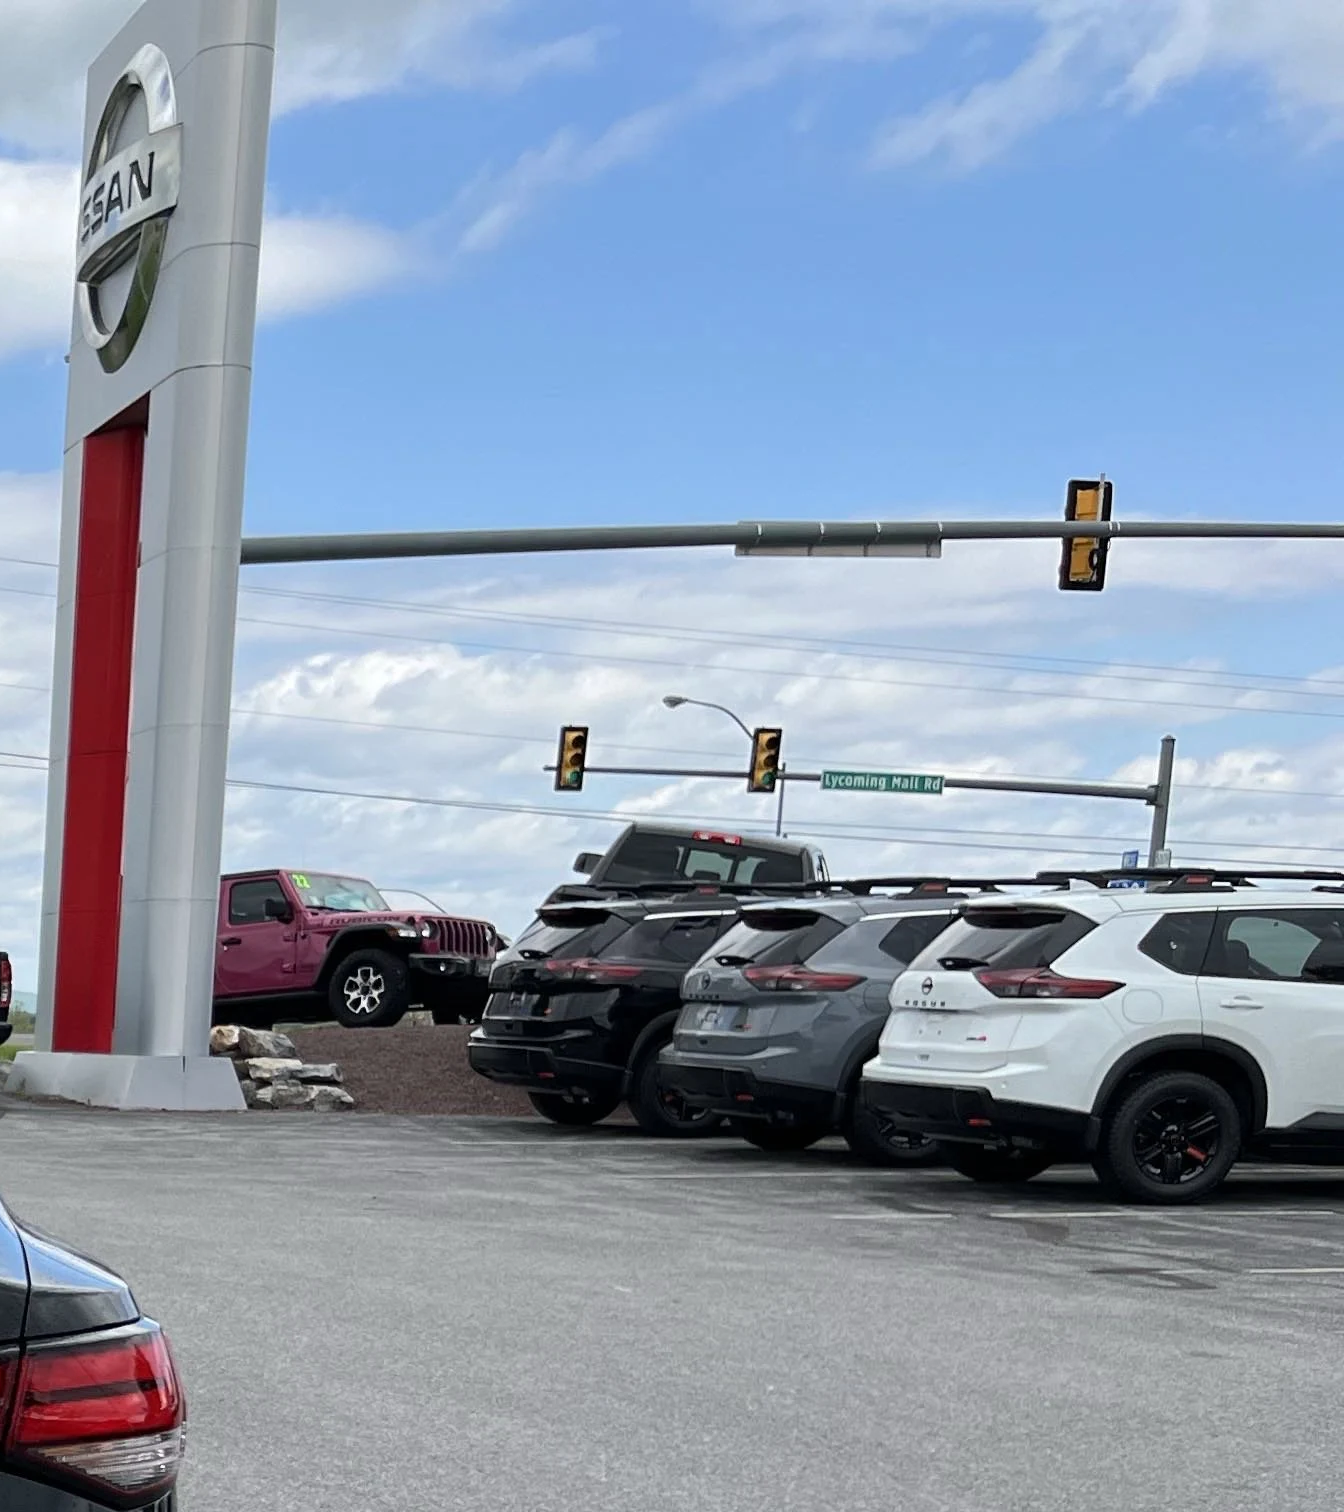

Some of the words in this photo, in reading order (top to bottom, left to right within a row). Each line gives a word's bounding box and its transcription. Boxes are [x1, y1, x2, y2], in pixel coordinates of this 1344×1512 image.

[824, 773, 886, 790] Lycoming
[891, 776, 918, 789] Mall
[924, 777, 941, 790] Rd
[292, 874, 311, 889] 22
